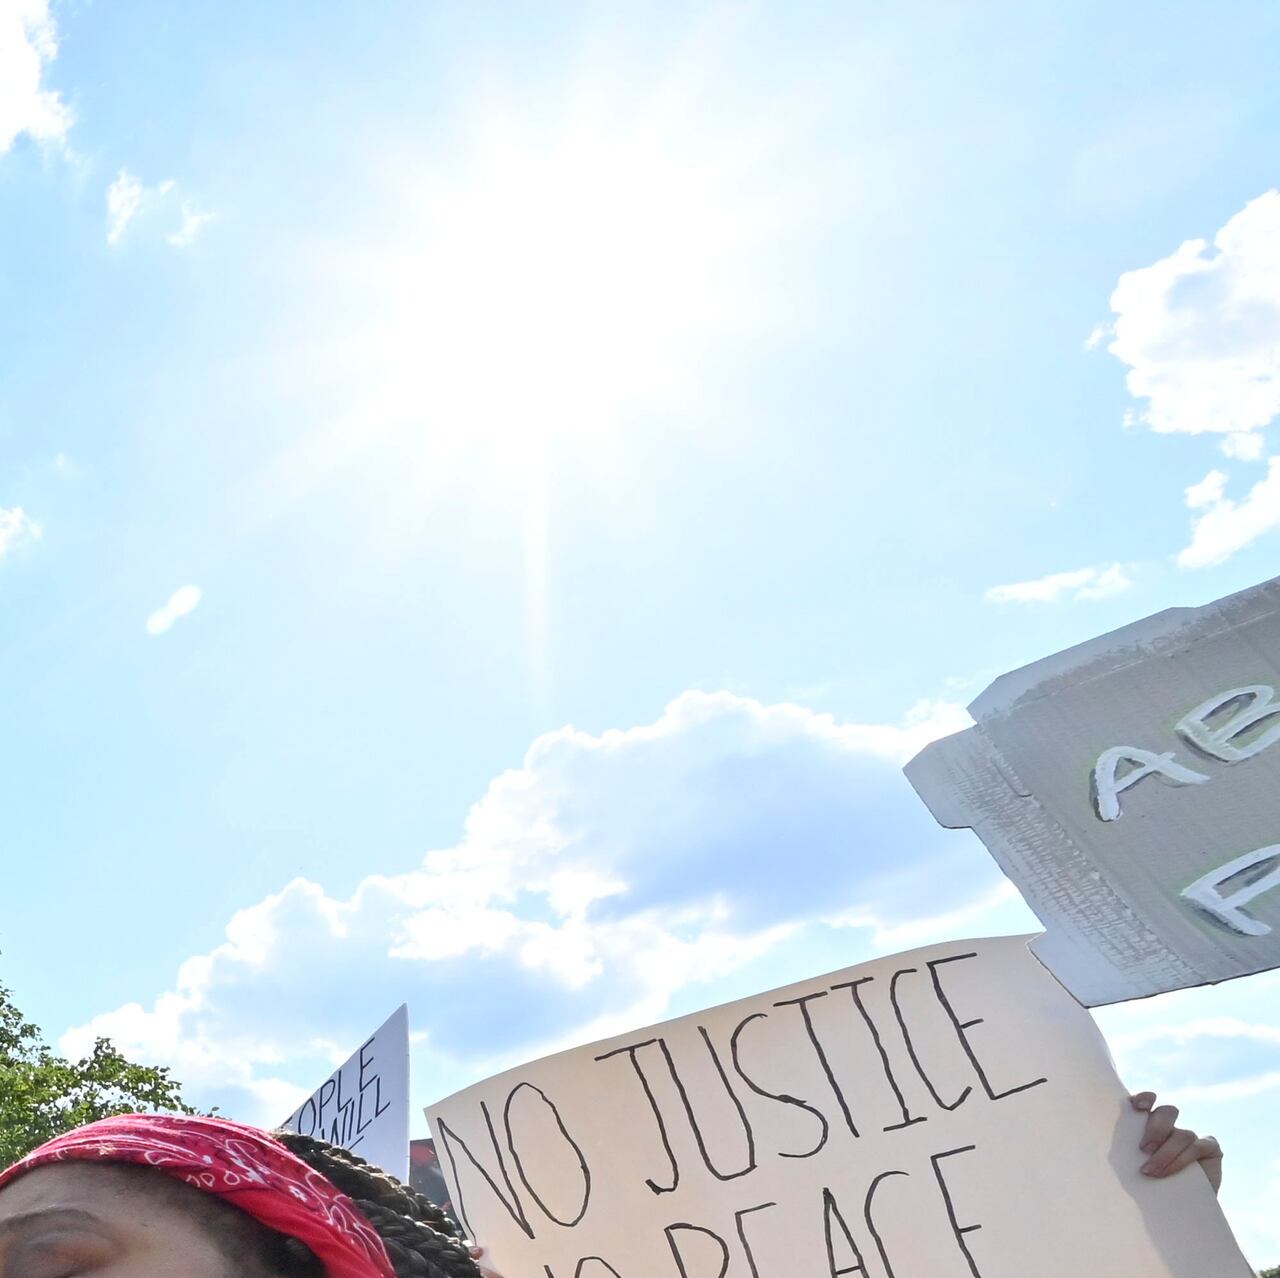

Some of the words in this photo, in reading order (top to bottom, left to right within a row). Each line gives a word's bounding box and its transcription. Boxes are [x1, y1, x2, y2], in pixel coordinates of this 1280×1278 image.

[282, 1037, 378, 1137] OPLE
[436, 1081, 591, 1247] NO
[594, 952, 1048, 1195] JUSTICE
